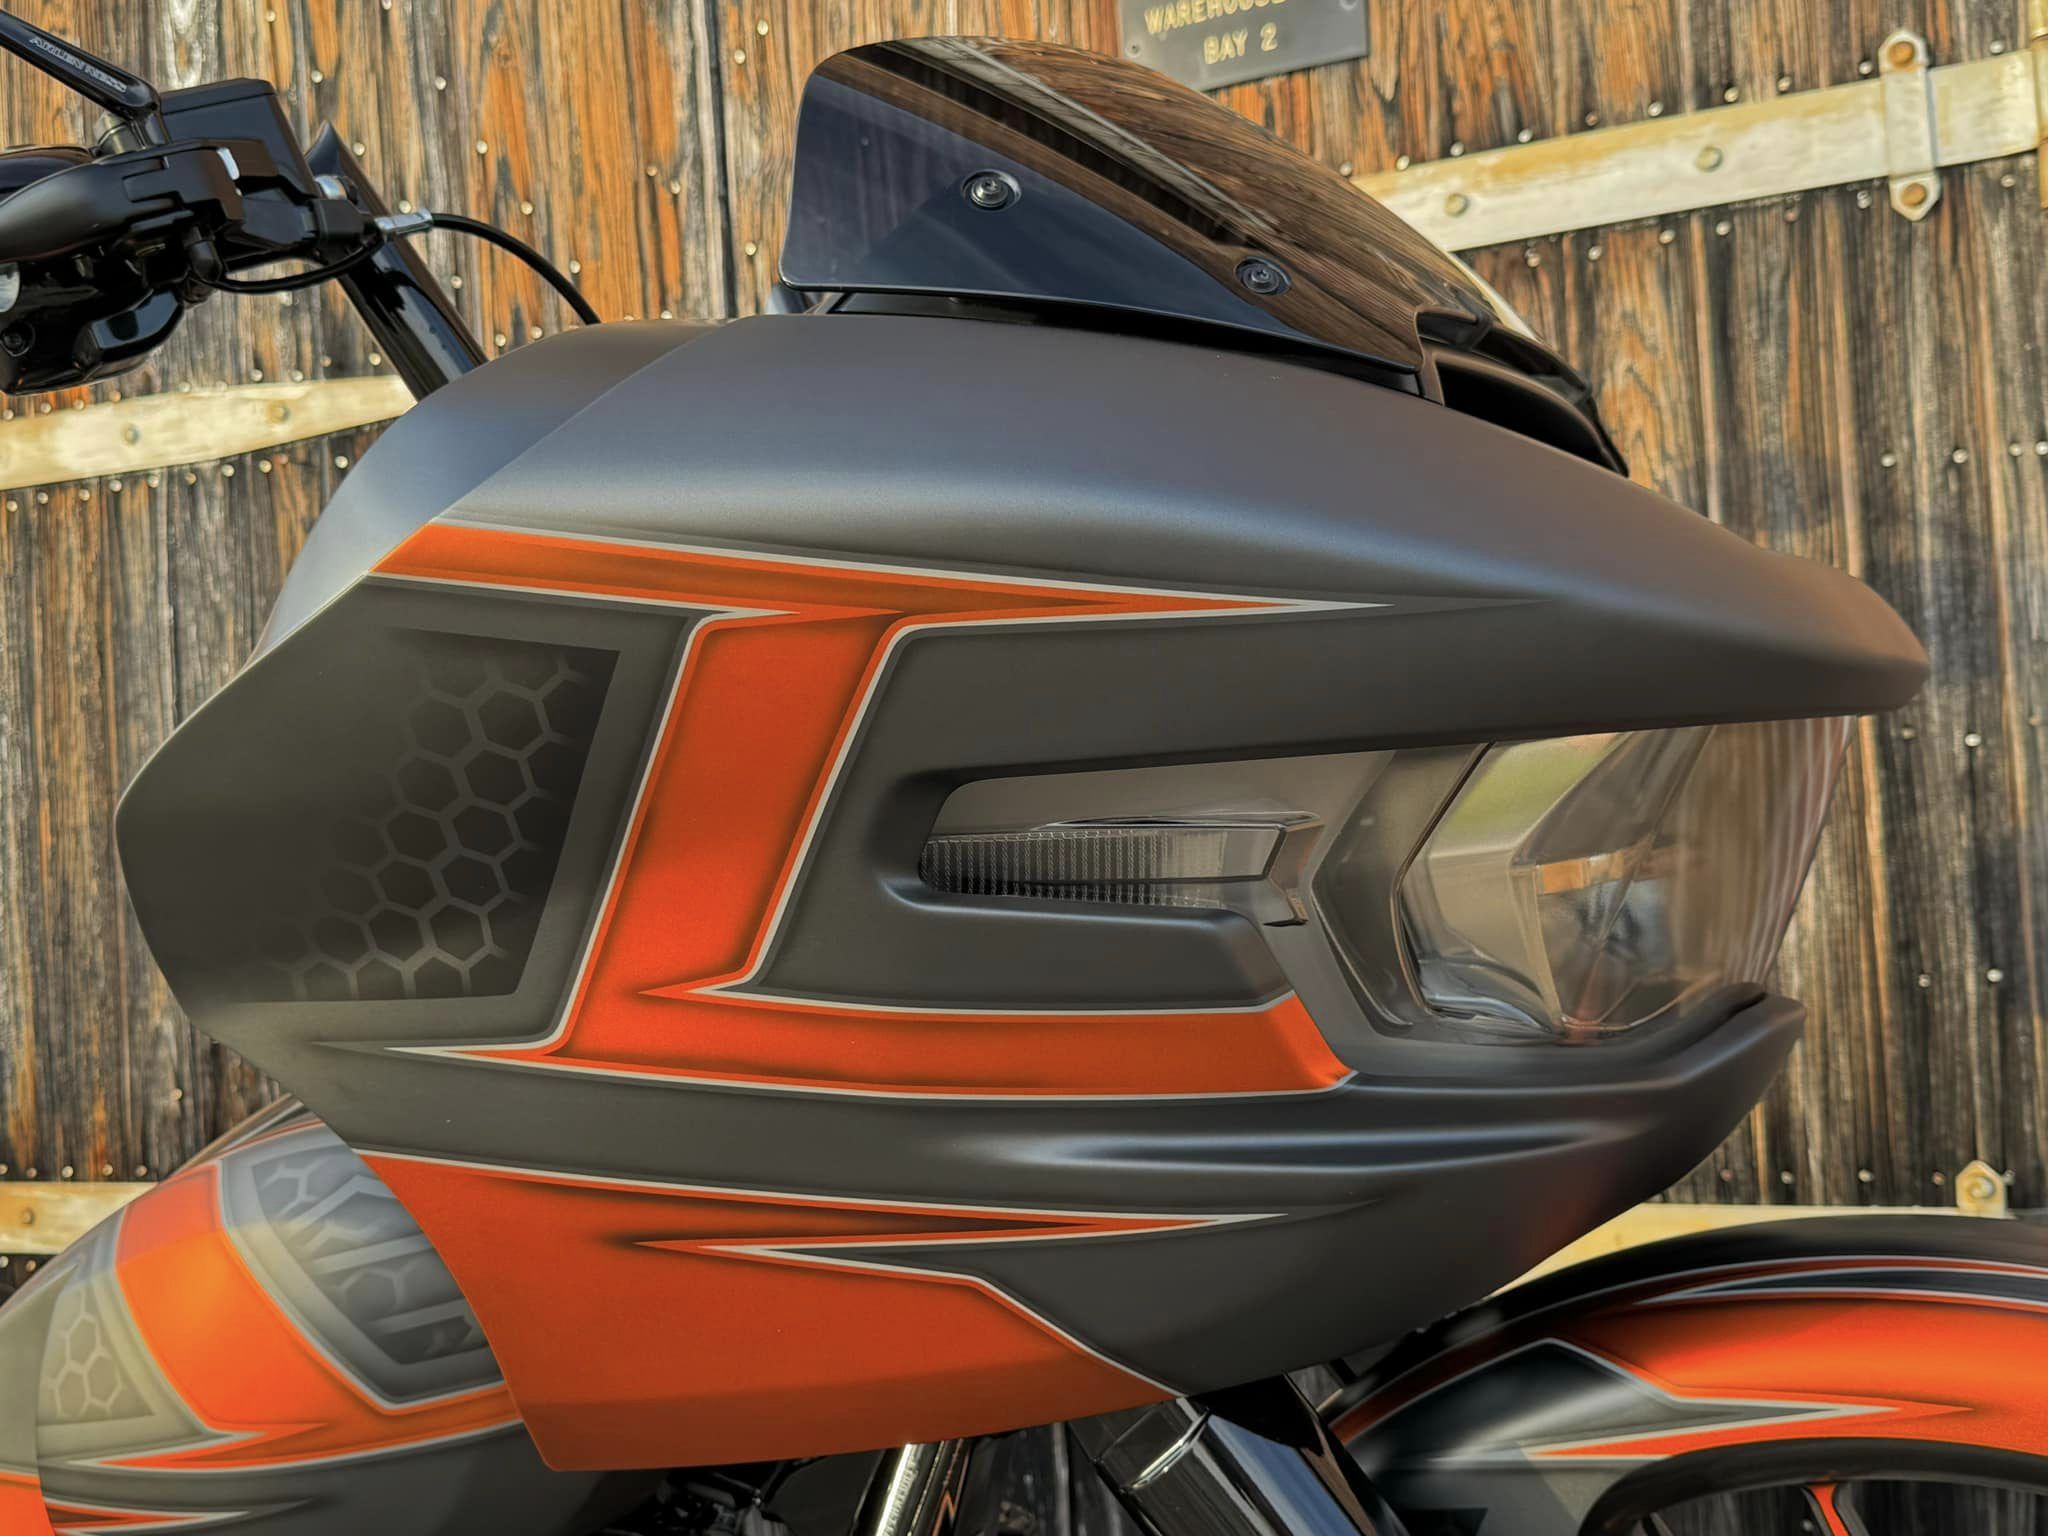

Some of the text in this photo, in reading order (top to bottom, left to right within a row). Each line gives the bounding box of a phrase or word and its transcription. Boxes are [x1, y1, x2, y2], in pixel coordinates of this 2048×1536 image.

[1144, 0, 1287, 35] WAREHO
[29, 36, 86, 70] ARLEN
[1204, 22, 1278, 64] BAY 2
